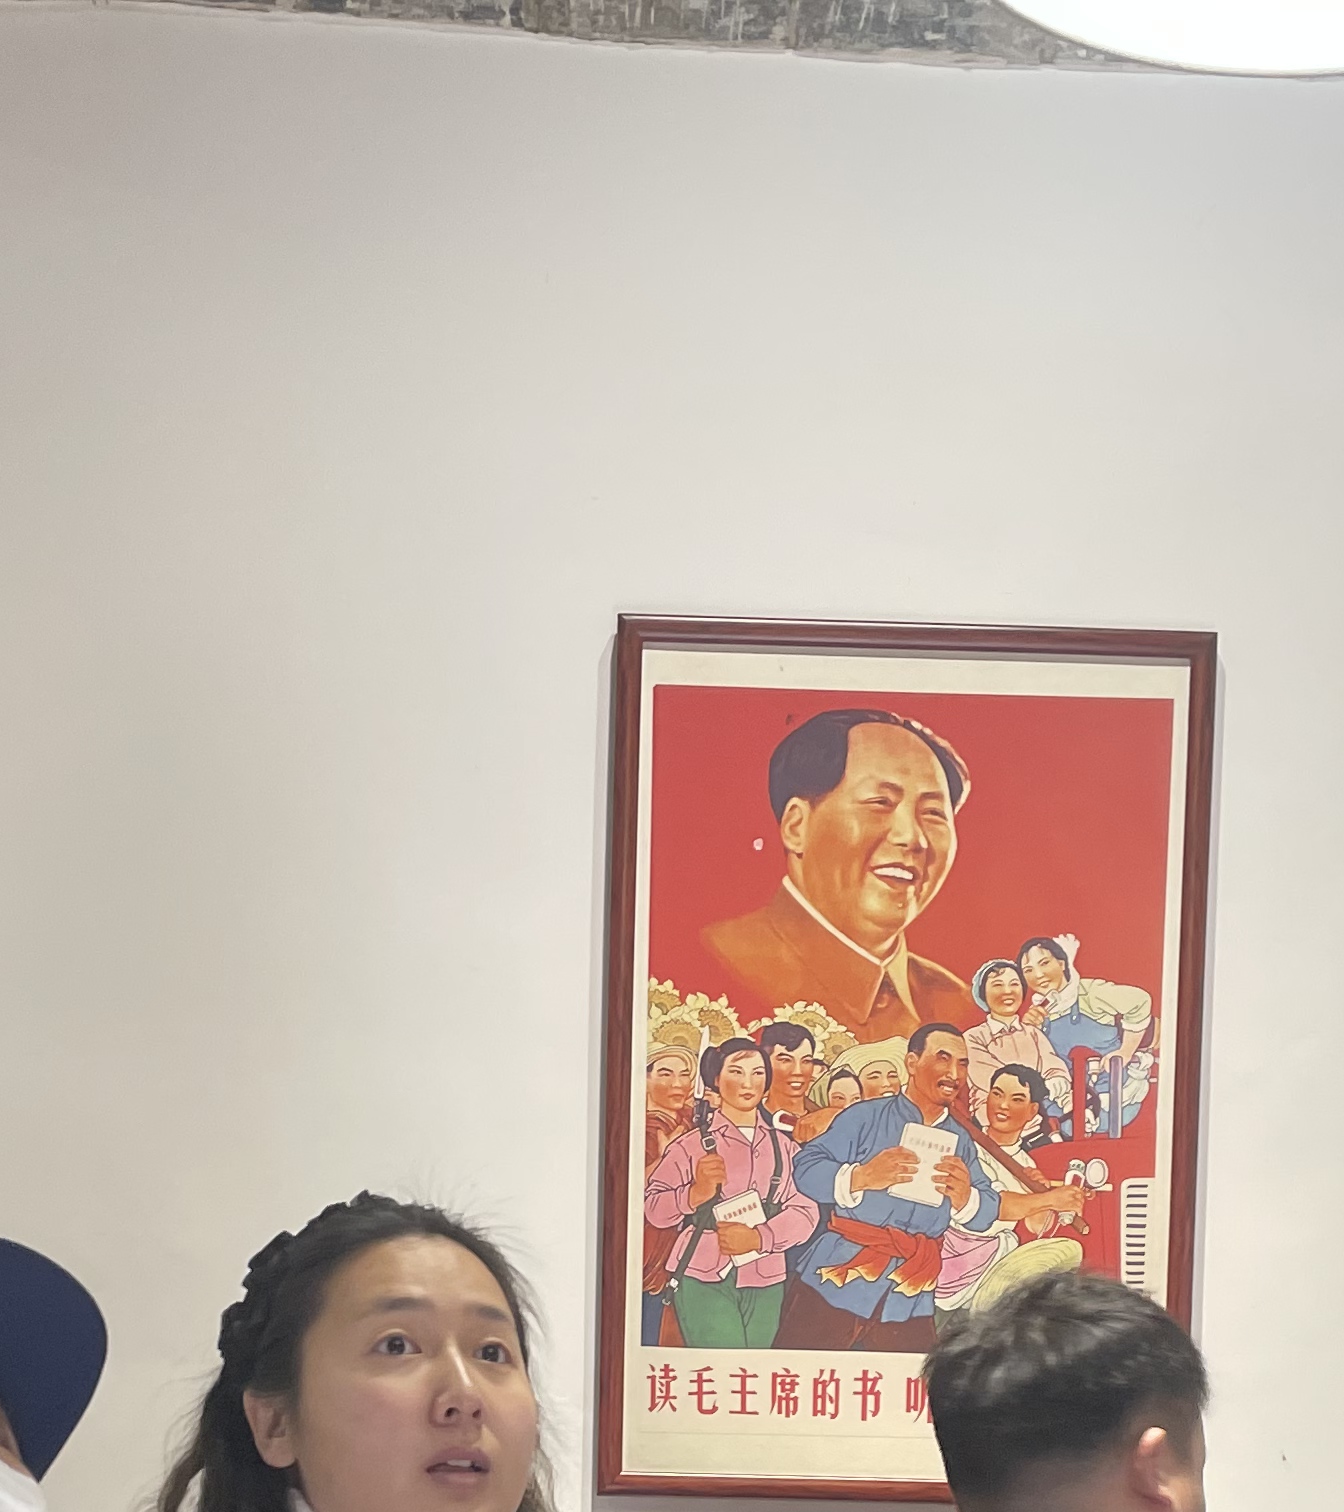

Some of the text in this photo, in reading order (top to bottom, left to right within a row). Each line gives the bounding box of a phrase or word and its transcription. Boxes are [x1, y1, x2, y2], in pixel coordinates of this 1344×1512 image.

[646, 1363, 884, 1422] 读毛主席的书
